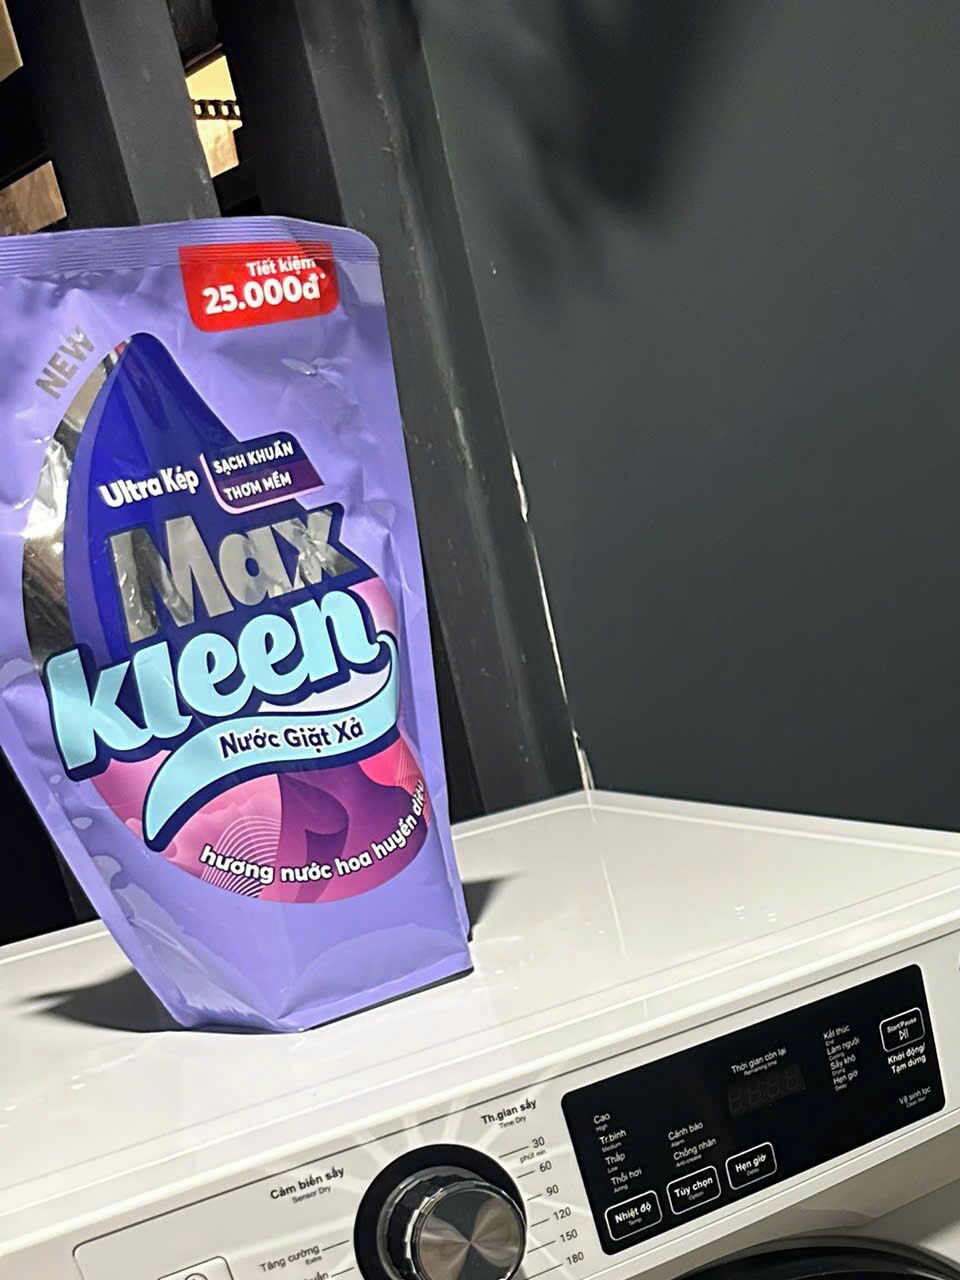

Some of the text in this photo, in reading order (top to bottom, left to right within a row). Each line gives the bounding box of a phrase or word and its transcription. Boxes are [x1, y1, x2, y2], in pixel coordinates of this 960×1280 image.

[246, 256, 316, 277] Tiết kiệm
[35, 324, 96, 399] NEW
[213, 440, 295, 477] SẠCH KHUẨN
[99, 466, 199, 508] Ultra Kép
[223, 480, 262, 502] THƠM
[109, 508, 359, 643] Max
[219, 716, 364, 759] Nước Giặt Xả
[200, 845, 274, 885] hương
[280, 859, 333, 883] nước
[336, 850, 373, 875] hoa
[519, 1097, 537, 1111] sấy
[593, 1113, 611, 1124] Cao
[531, 1135, 546, 1149] 30
[539, 1160, 553, 1174] 60
[735, 1153, 767, 1172] Hẹn giờ
[270, 1166, 344, 1200] Cảm biến sấy
[546, 1184, 560, 1197] 90
[692, 1176, 714, 1191] chọn
[292, 1185, 331, 1204] Sensor Dry
[553, 1206, 573, 1221] 120
[614, 1201, 653, 1223] Nhiệt độ
[560, 1228, 579, 1243] 150
[259, 1245, 320, 1272] Tăng cường
[567, 1251, 585, 1266] 180
